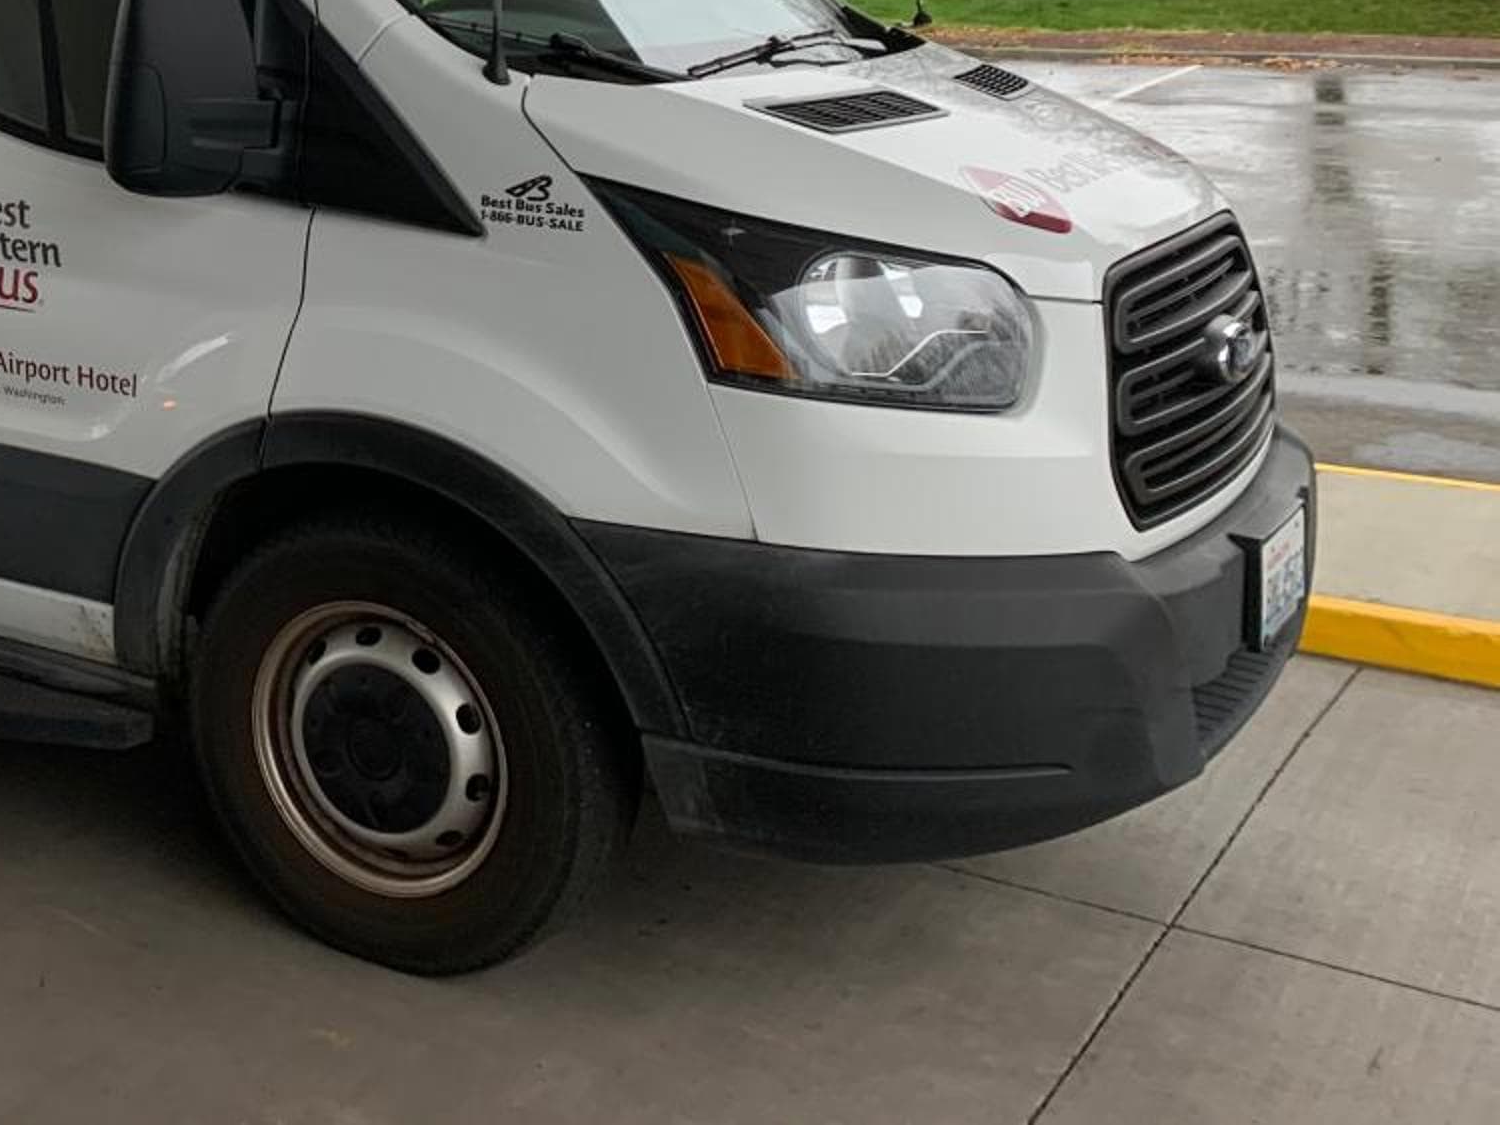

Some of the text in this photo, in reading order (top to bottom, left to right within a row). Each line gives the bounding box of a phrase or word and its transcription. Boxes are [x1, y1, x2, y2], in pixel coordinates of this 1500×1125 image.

[481, 194, 585, 218] Best Bus Sales
[77, 364, 138, 398] Hotel
